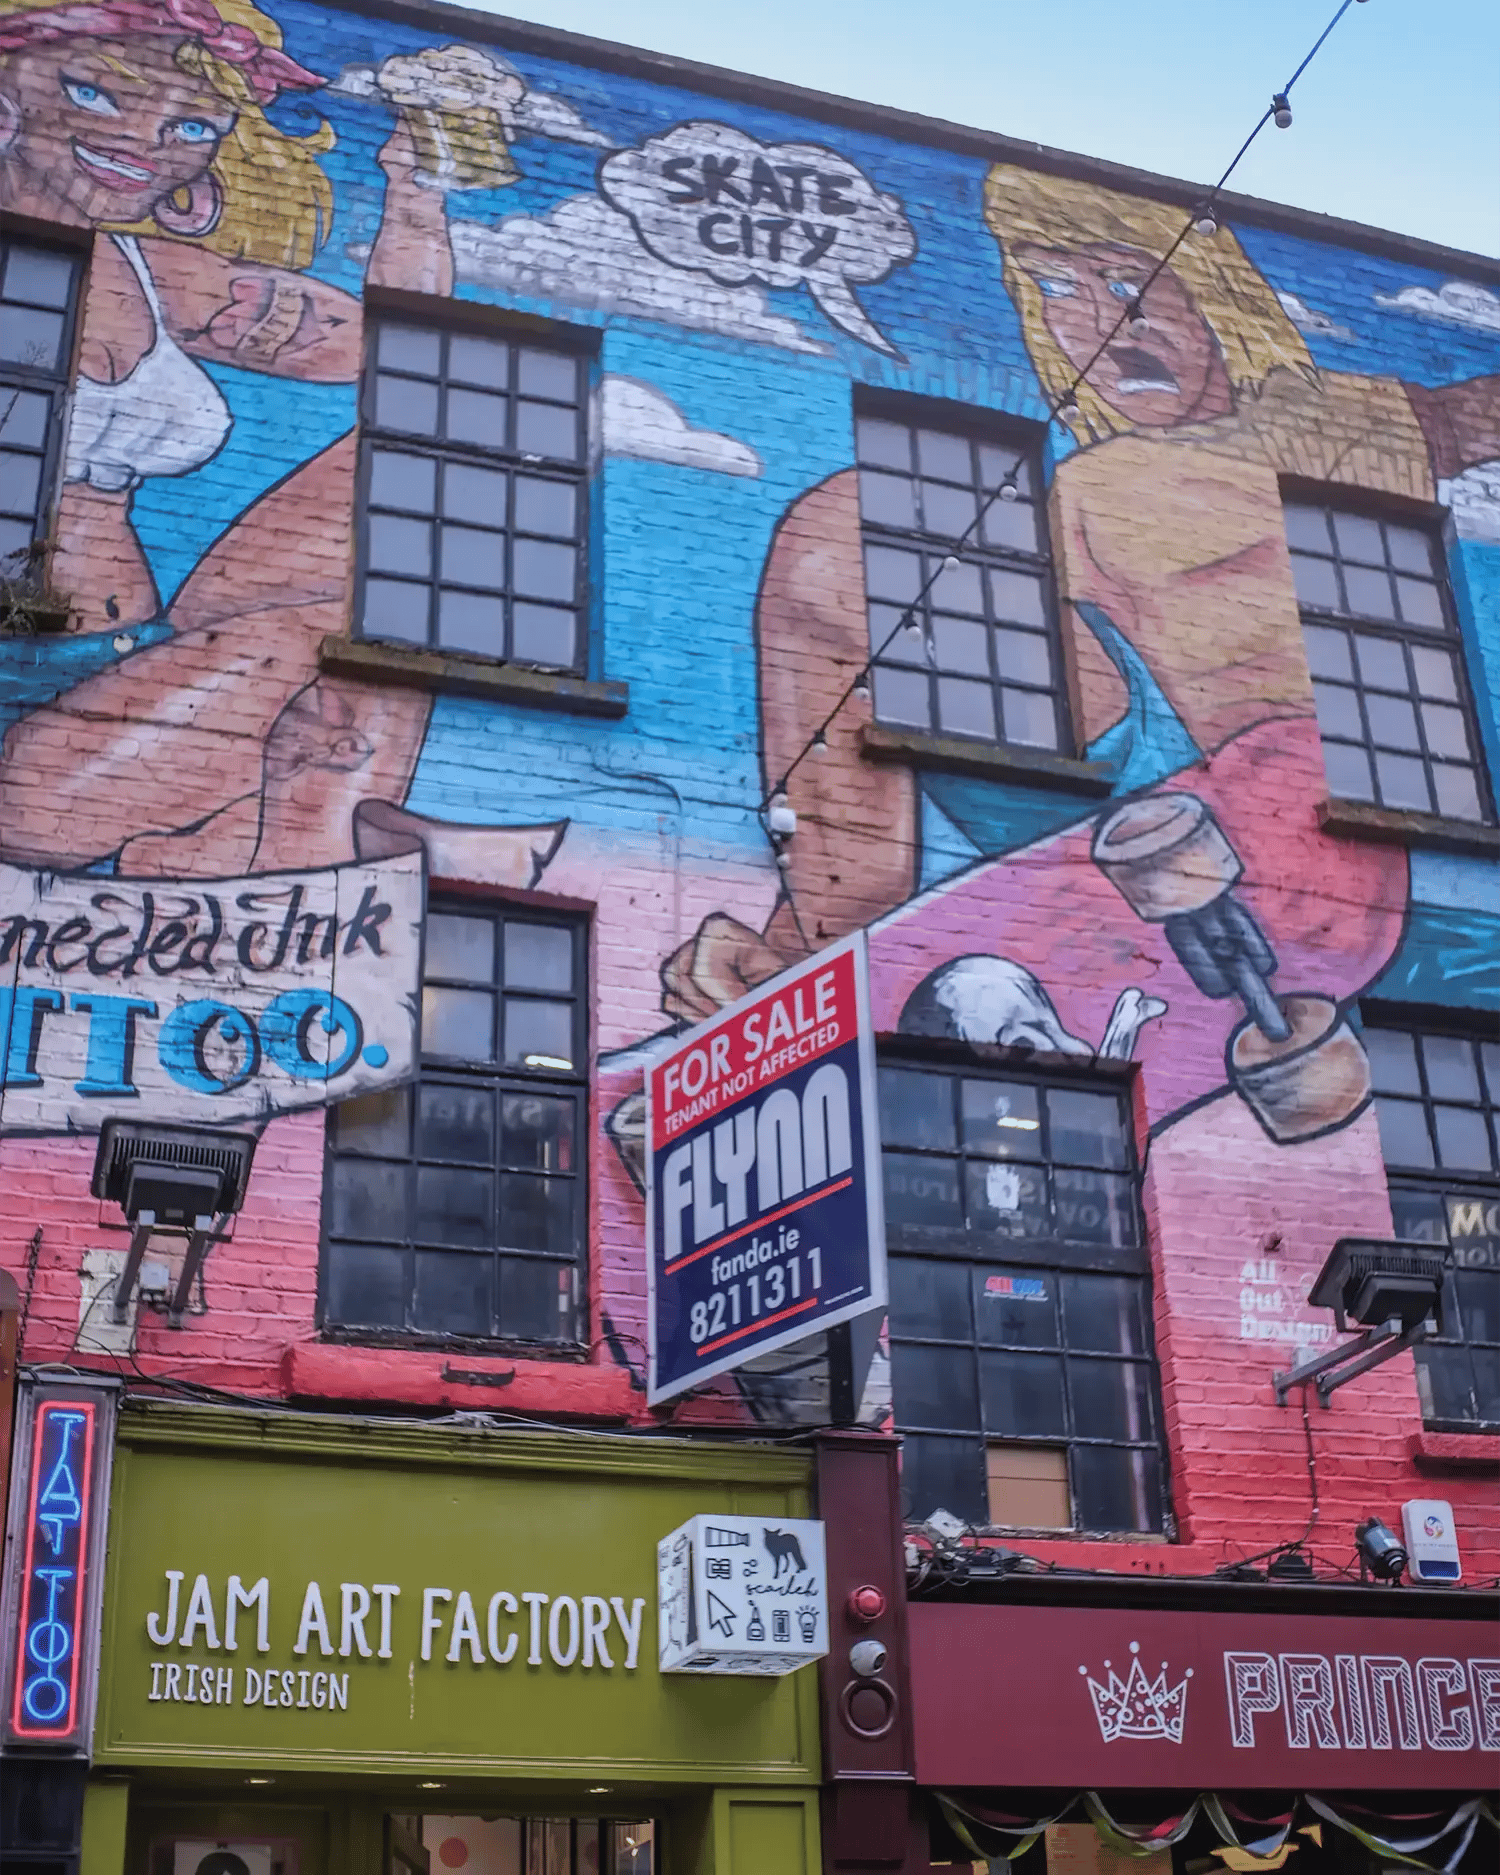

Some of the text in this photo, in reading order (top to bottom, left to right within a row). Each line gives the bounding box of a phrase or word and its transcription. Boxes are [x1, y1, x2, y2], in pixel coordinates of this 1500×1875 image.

[662, 154, 857, 215] SKATE
[700, 213, 837, 267] CITY
[236, 884, 392, 972] Ink
[663, 970, 837, 1112] FOR SALE
[664, 1022, 840, 1135] TENANT NOT AFFECTED
[663, 1063, 852, 1261] FLYNN
[690, 1247, 822, 1344] 8211311
[711, 1225, 800, 1286] fanda.ie
[24, 1411, 86, 1720] TATTOO
[147, 1570, 646, 1670] JAM ART FACTORY
[148, 1662, 349, 1711] IRISH DESIGN
[1223, 1650, 1500, 1752] PRINCE
